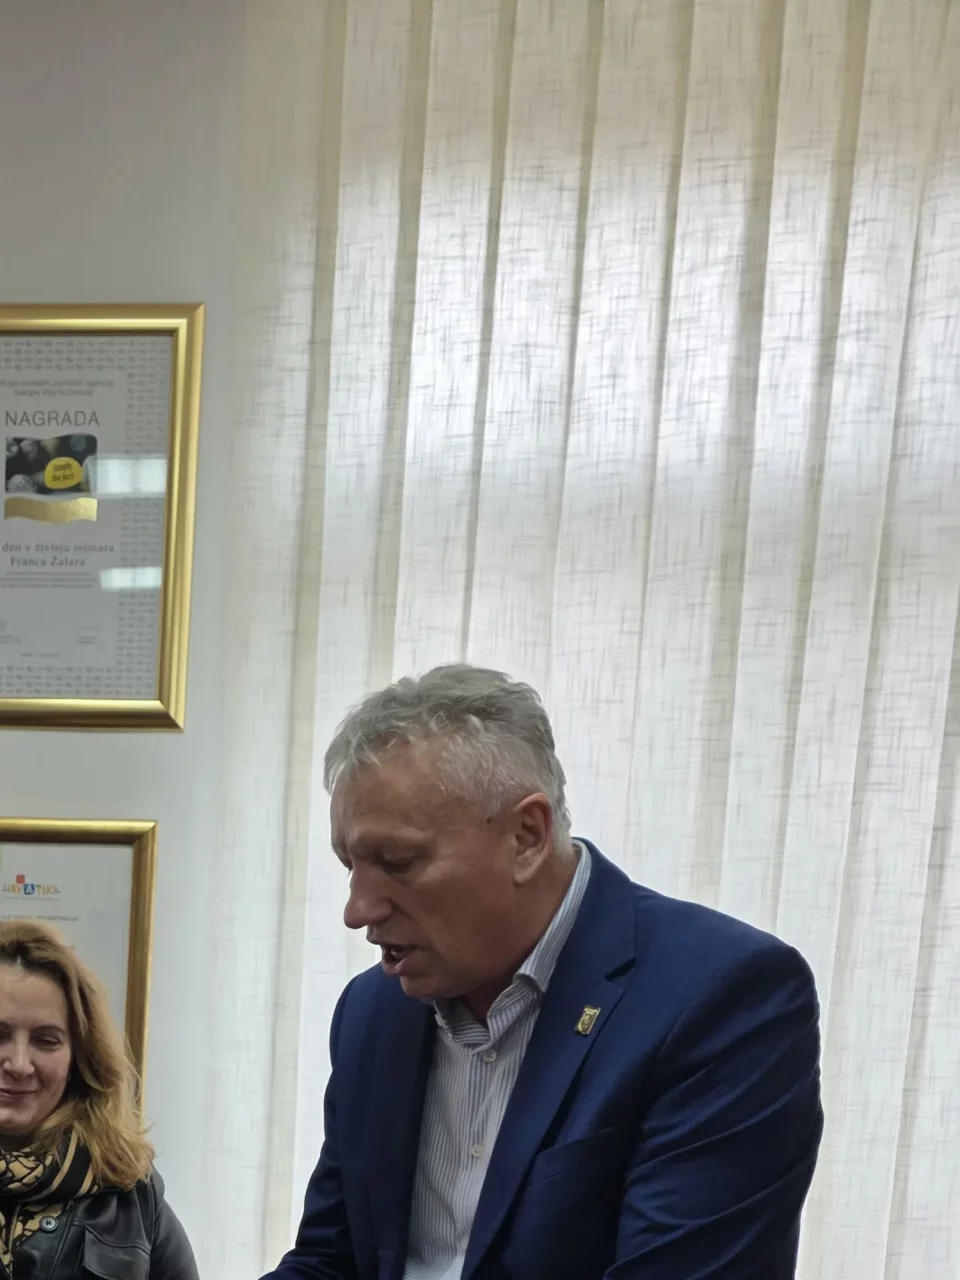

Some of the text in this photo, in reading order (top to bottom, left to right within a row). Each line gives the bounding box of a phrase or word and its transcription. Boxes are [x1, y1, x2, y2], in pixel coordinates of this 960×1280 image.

[5, 411, 100, 426] NAGRADA
[2, 542, 21, 552] den
[10, 555, 86, 567] Franca Žalara
